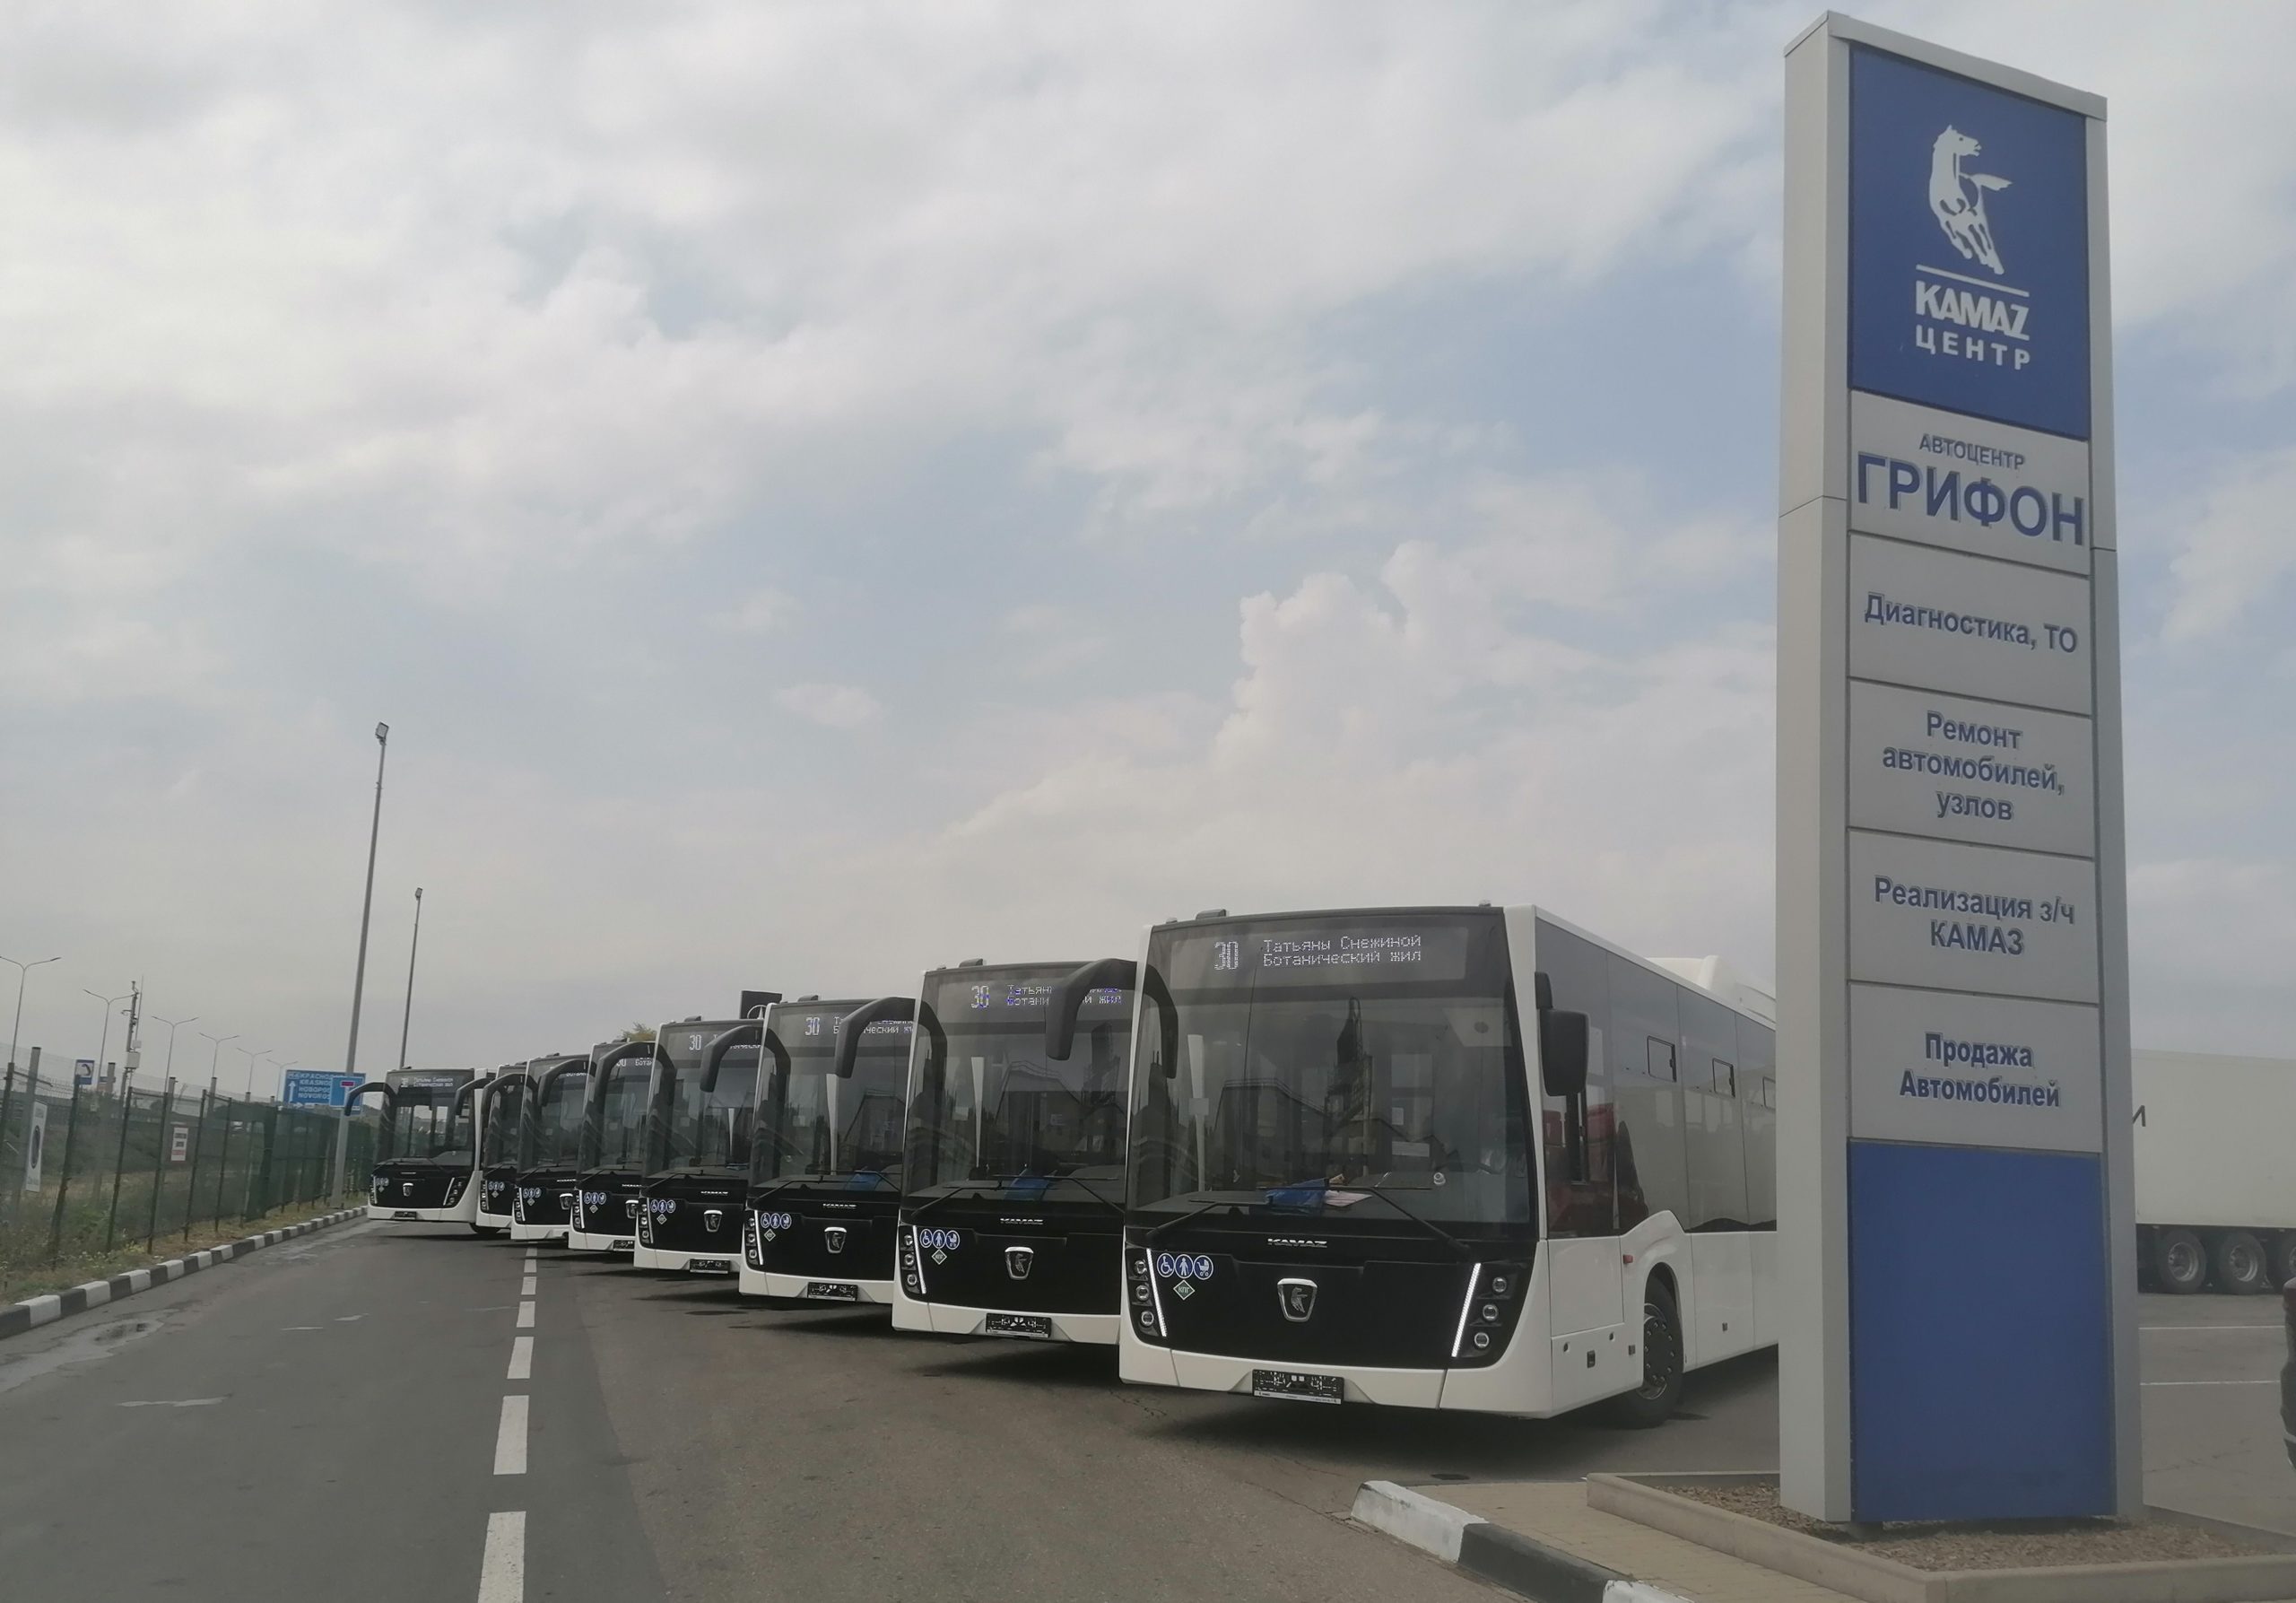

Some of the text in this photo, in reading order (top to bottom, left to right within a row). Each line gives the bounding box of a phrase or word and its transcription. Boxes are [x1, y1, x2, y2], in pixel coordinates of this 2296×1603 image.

[1916, 280, 2030, 341] KAMAZ
[1916, 325, 2031, 370] ЦЕНТР
[1919, 433, 2025, 471] АВТОЦЕНТР
[1857, 451, 2084, 546] ГРИФОН
[1865, 592, 2079, 653] Диагностика, ТО
[1926, 710, 2022, 749] Ремонт
[1883, 746, 2065, 796] автомобилей,
[1935, 791, 2013, 821] узлов
[1874, 876, 2075, 925] Реализация з/ч
[1263, 935, 1422, 953] Татьяны Снежиной
[1930, 919, 2024, 955] КАМАЗ
[1214, 941, 1239, 971] 30
[1263, 951, 1422, 967] Ботанический жил
[970, 985, 990, 1008] 30
[689, 1034, 702, 1051] 30
[804, 1016, 821, 1036] 30
[1925, 1032, 2033, 1068] Продажа
[1899, 1070, 2060, 1107] Автомобилей
[1267, 1238, 1327, 1249] KAMAZ
[1178, 1285, 1191, 1294] КПГ
